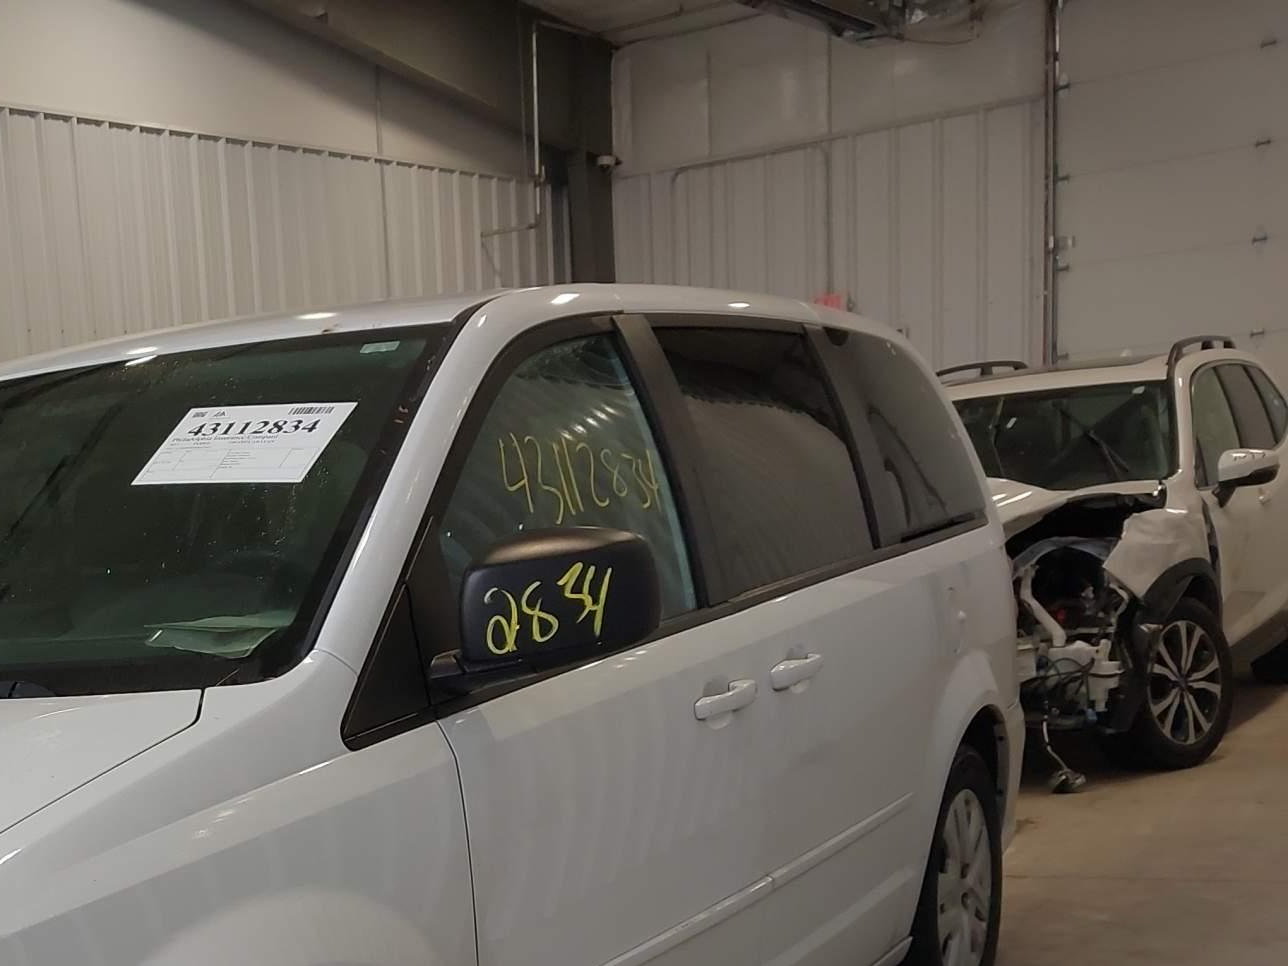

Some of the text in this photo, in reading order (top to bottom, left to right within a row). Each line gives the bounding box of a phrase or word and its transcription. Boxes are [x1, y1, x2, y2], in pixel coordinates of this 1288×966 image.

[187, 418, 321, 437] 43112834
[498, 433, 661, 524] 43112834
[484, 562, 613, 655] 2834
